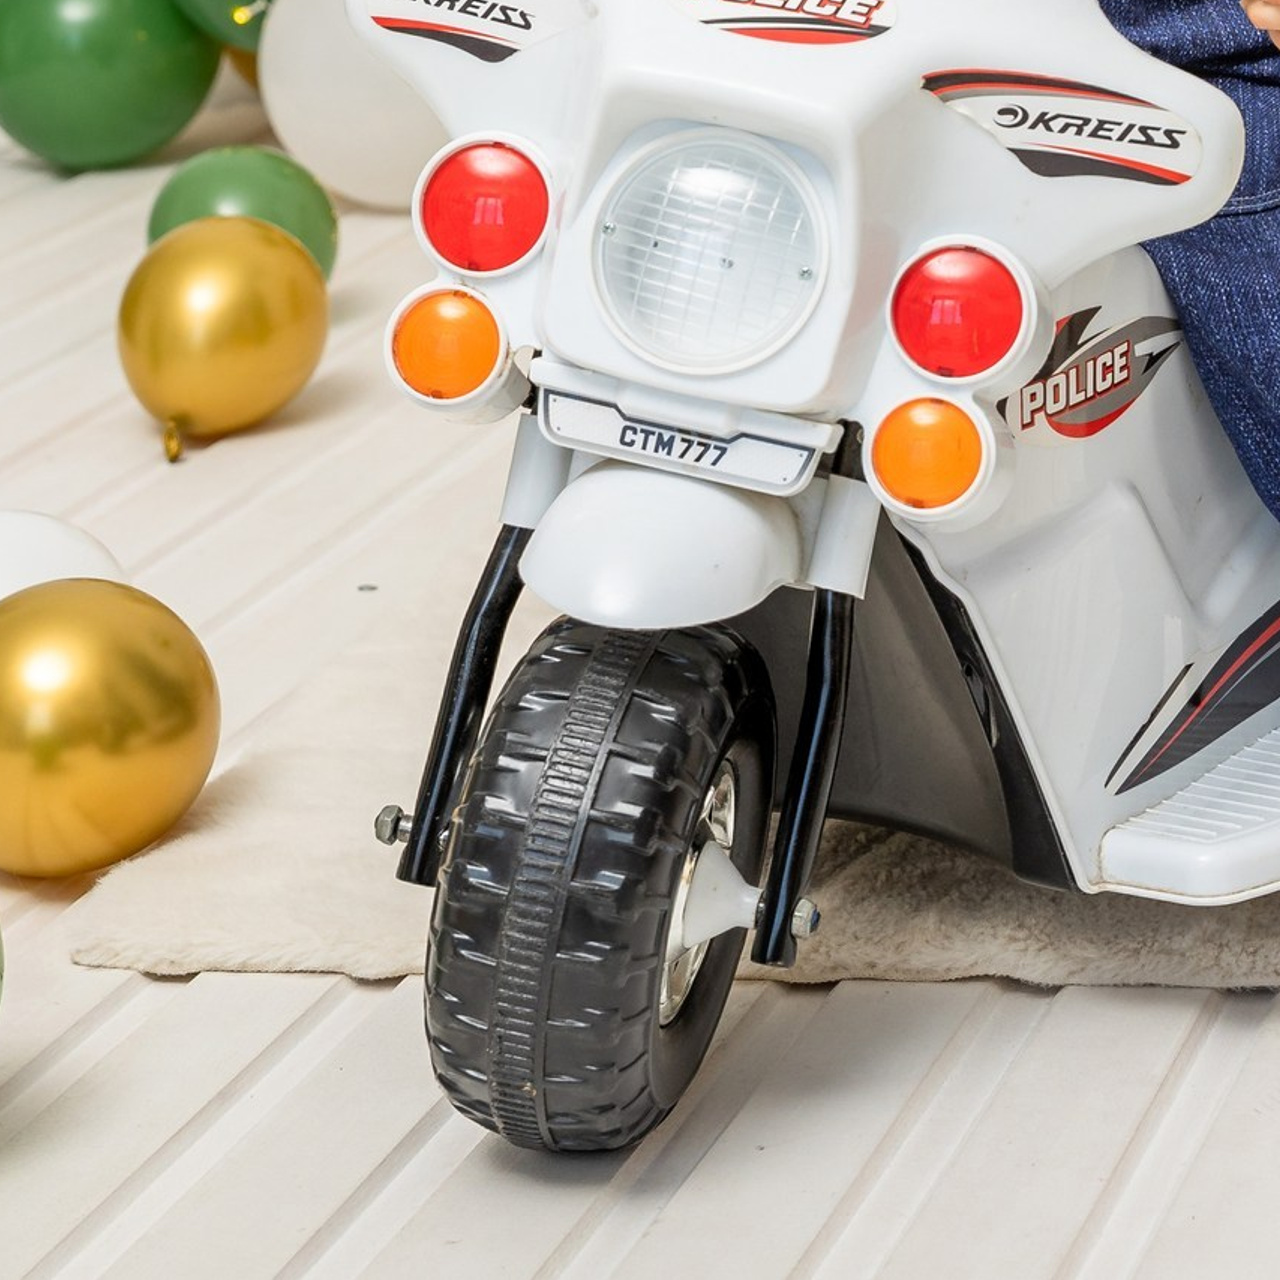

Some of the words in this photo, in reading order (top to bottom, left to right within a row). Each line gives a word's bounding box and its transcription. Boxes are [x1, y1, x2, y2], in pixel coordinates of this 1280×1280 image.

[1028, 111, 1187, 149] KREISS
[1020, 339, 1131, 431] POLICE
[619, 424, 728, 467] CTM777
